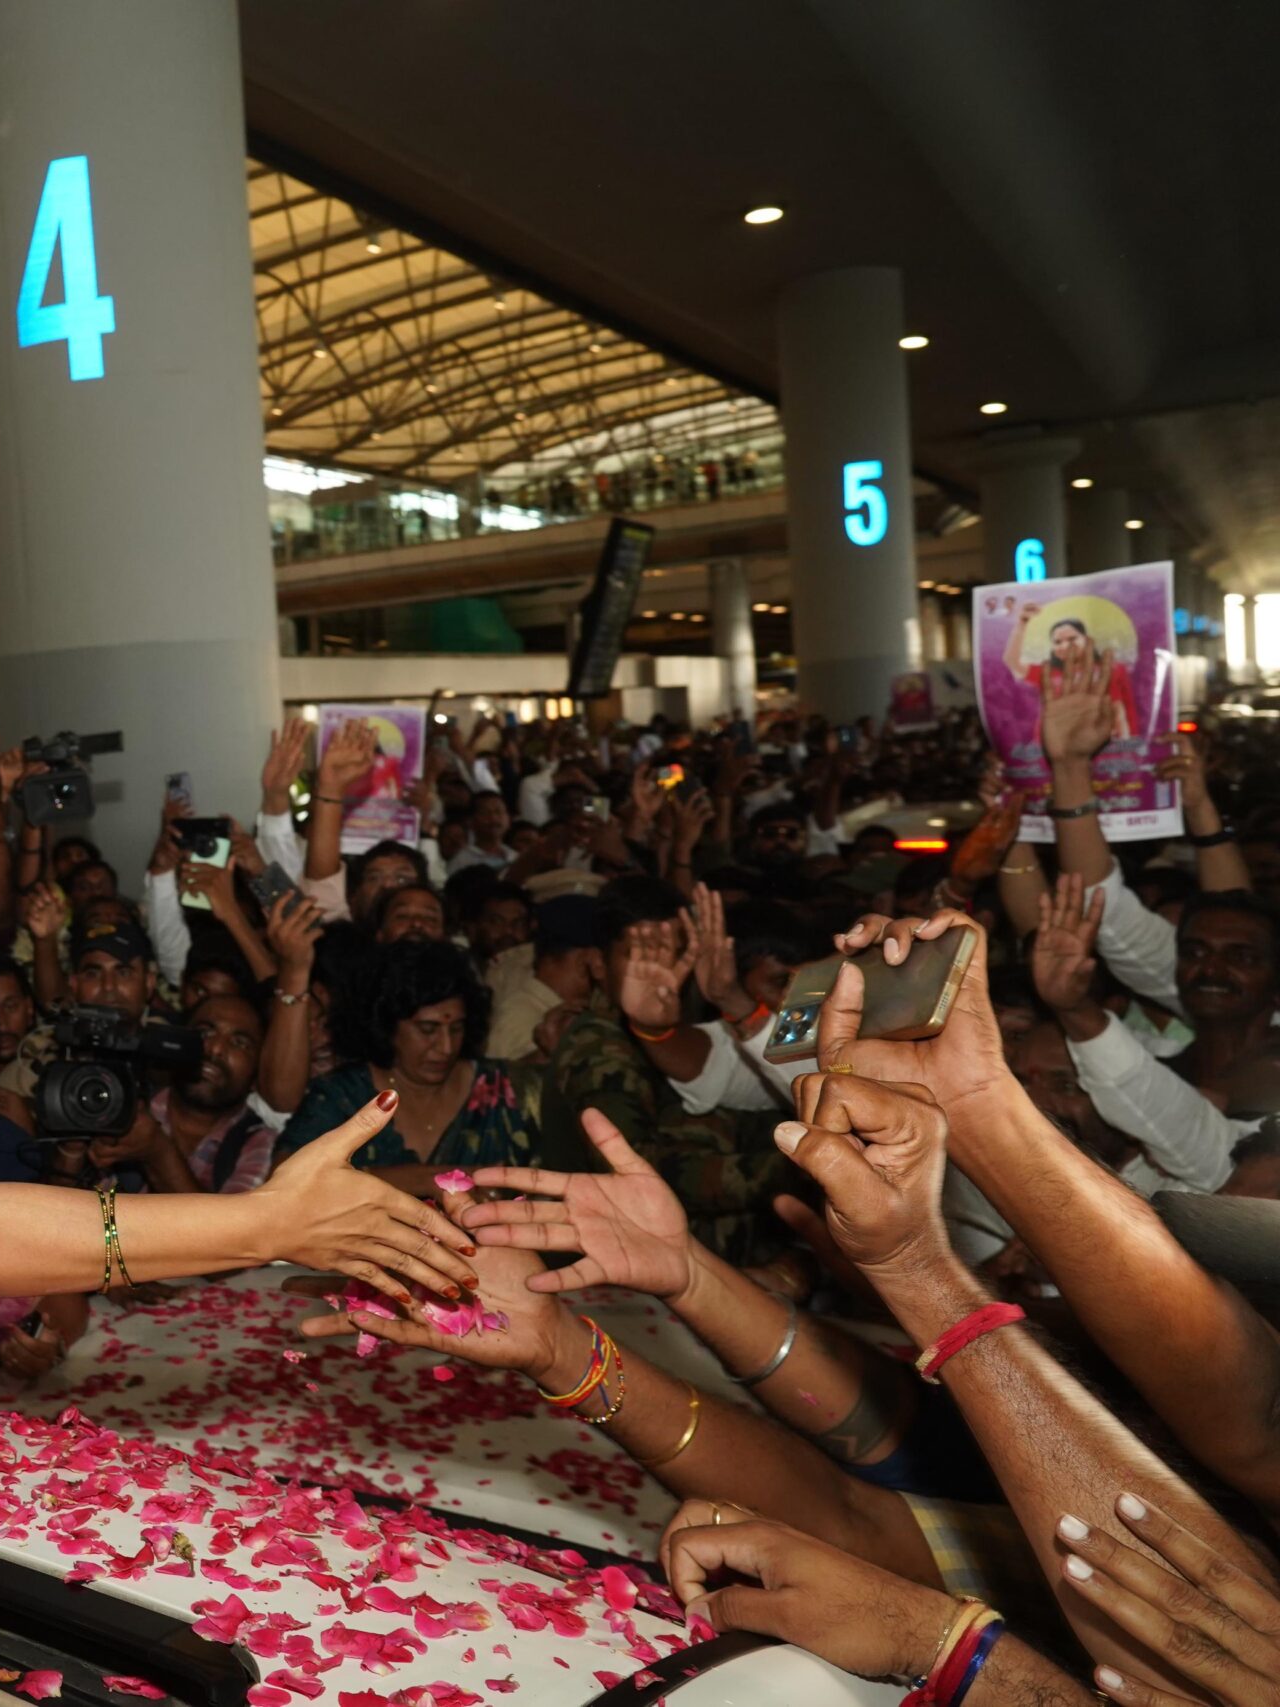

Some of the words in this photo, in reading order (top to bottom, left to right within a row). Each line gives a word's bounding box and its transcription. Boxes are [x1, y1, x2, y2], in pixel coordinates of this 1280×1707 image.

[16, 154, 117, 383] 4
[842, 459, 889, 547] 5
[1014, 538, 1048, 585] 6
